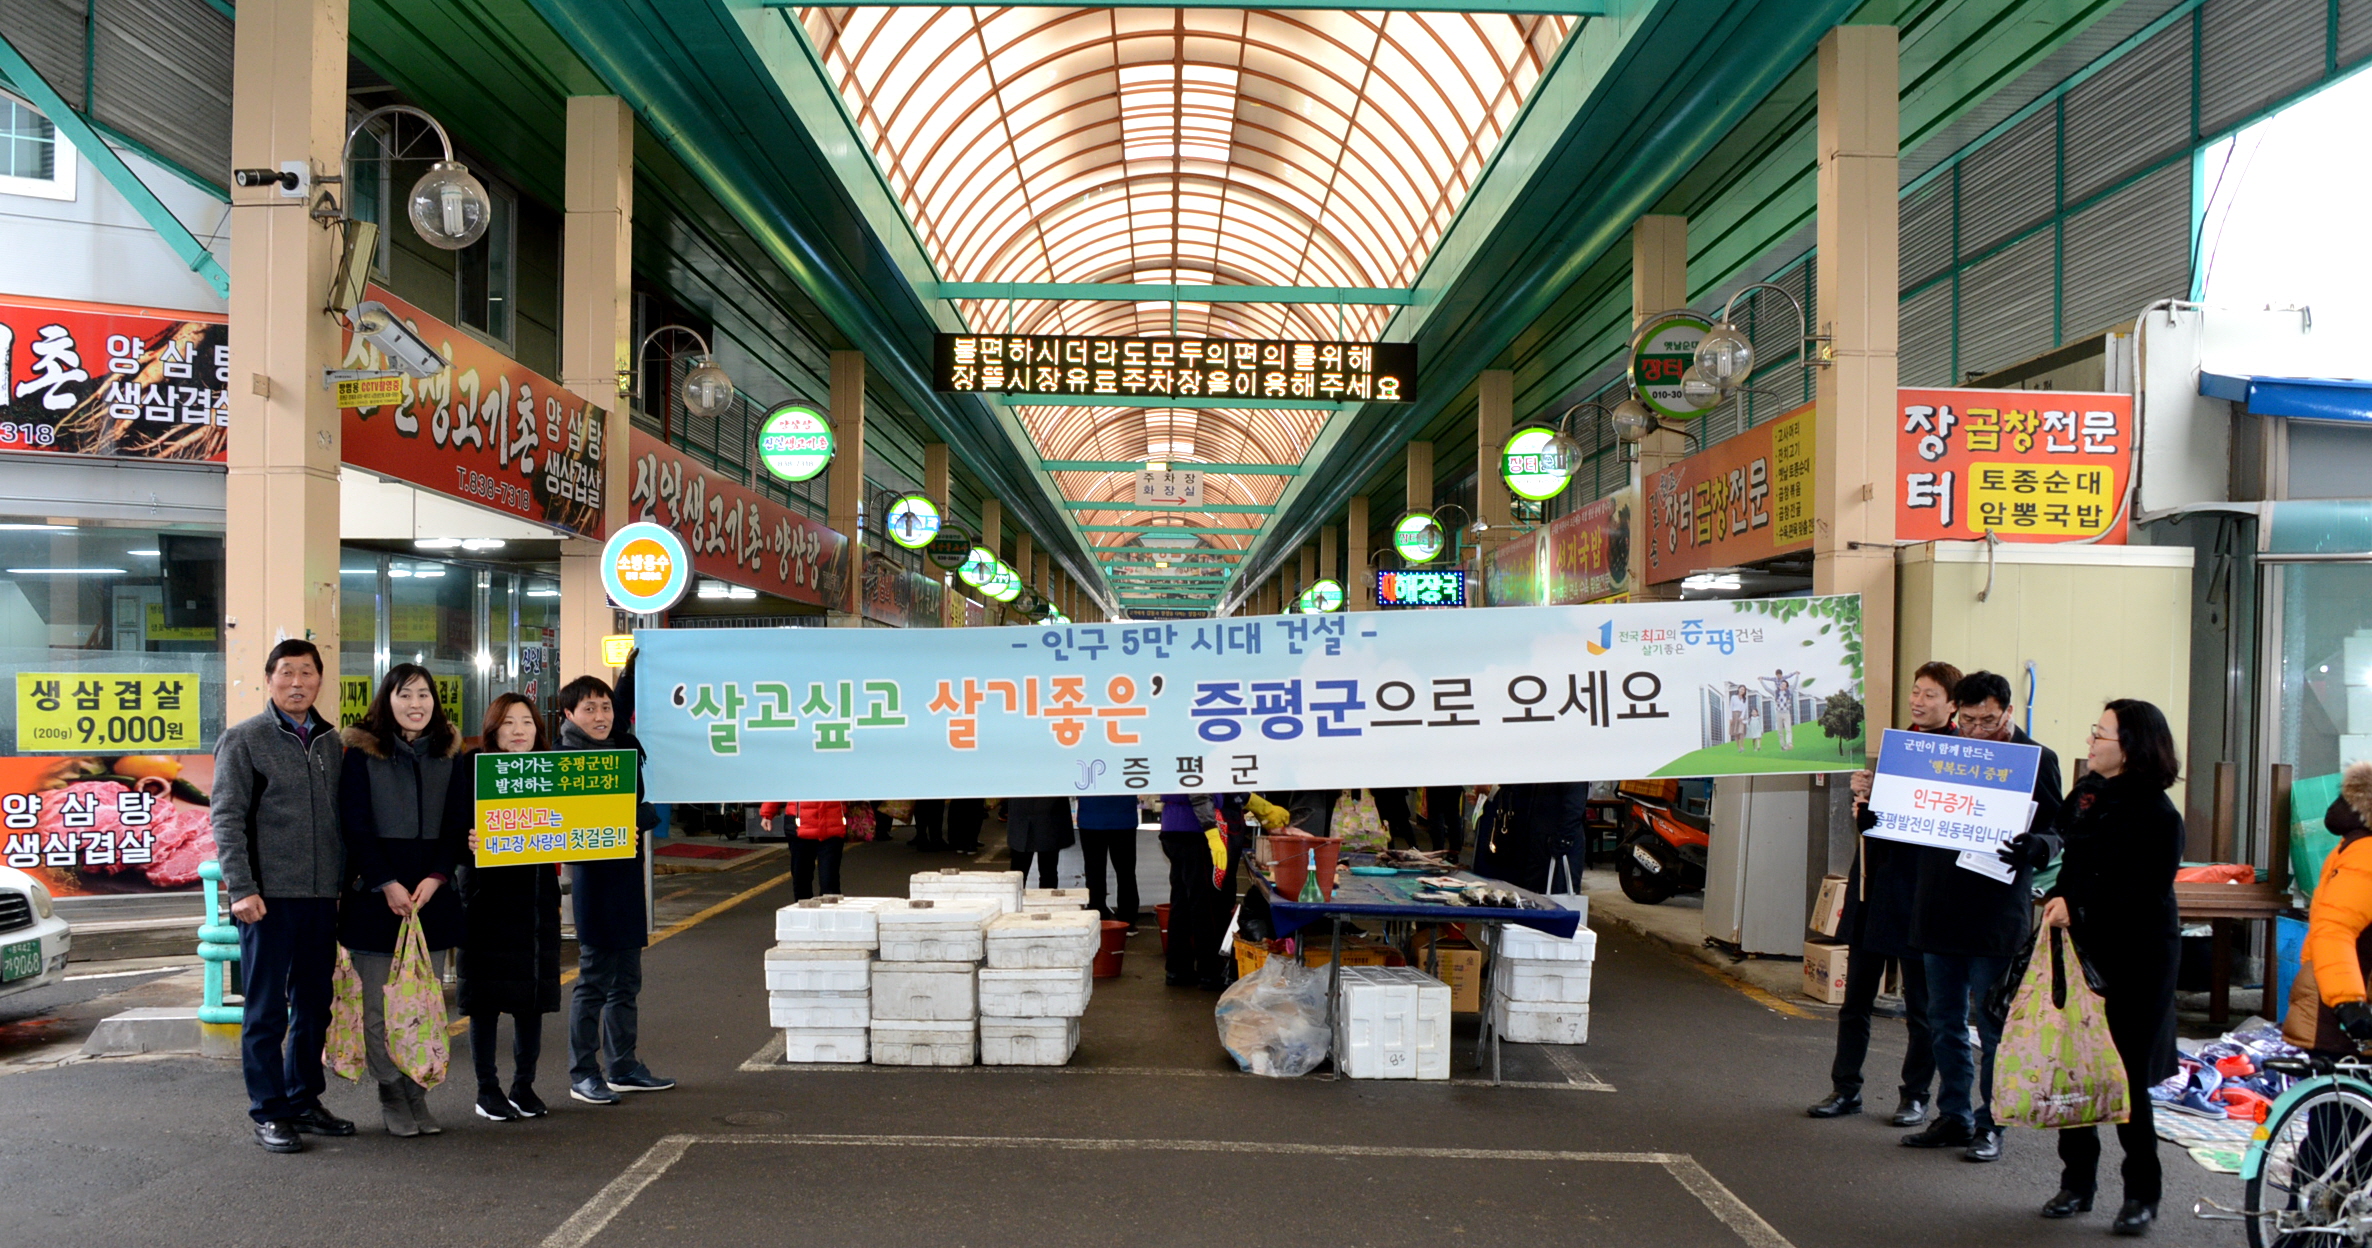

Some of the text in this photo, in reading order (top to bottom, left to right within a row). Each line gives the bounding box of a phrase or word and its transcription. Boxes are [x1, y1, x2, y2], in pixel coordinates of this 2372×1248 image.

[546, 396, 602, 460] 양삼탕
[1964, 408, 2120, 454] 곱창전문
[457, 466, 530, 511] T.838-7318
[544, 450, 602, 509] 생삼겹살
[1143, 472, 1196, 484] 주차장
[1143, 485, 1195, 496] 화장실
[1980, 469, 2102, 496] 토종순대
[1980, 502, 2104, 528] 암뽕국밥
[617, 554, 670, 571] 소방용수
[1042, 615, 1345, 661] 인구 5만 시대 건설
[1618, 631, 1639, 643] 전국
[1640, 629, 1676, 644] 최고의
[1641, 643, 1685, 656] 살기좋은
[30, 680, 183, 711] 생삼겹살
[1190, 678, 1480, 742] 증평군으로
[1502, 669, 1669, 728] 오세요
[33, 715, 184, 745] (200g) 9,000원
[1904, 738, 1995, 761] 군민이 함께 만드는
[495, 755, 619, 774] 늘어가는 증평군민!
[1122, 754, 1259, 788] 증평군
[495, 774, 619, 794] 발전하는 우리고장!
[2, 792, 155, 829] 양삼탕
[1913, 789, 1986, 817] 인구증가는
[485, 807, 562, 831] 전입신고는
[1875, 811, 1935, 836] 증평발전의
[2, 831, 156, 868] 생삼겹살
[485, 827, 627, 854] 내고장 사랑의 첫걸음!!
